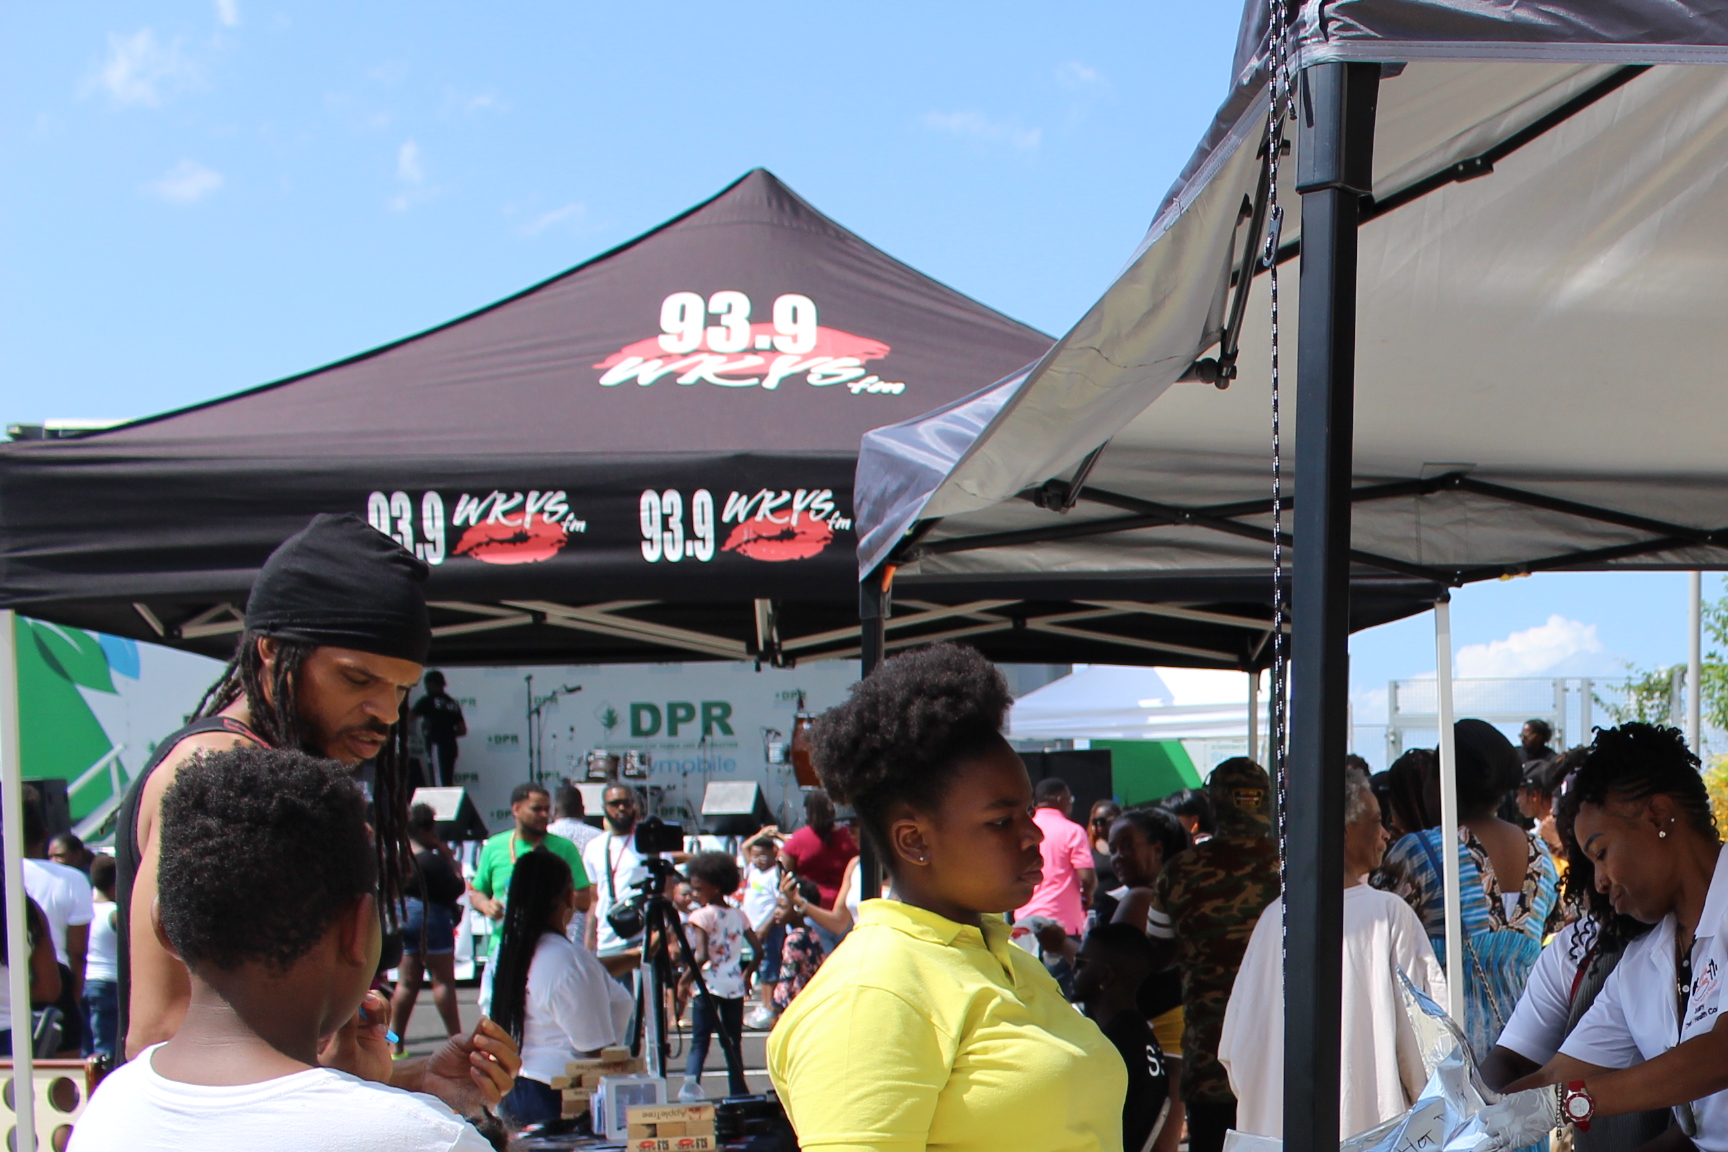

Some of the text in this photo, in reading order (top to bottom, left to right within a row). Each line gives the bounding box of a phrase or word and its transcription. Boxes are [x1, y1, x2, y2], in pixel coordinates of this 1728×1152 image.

[657, 290, 817, 354] 93.9
[599, 353, 905, 394] WKYS fm
[452, 490, 570, 528] WKYS
[640, 488, 715, 563] 93.9
[722, 488, 832, 529] WKYS
[630, 701, 735, 737] DPR
[494, 733, 519, 745] DPR
[641, 1109, 688, 1120] AppleTree
